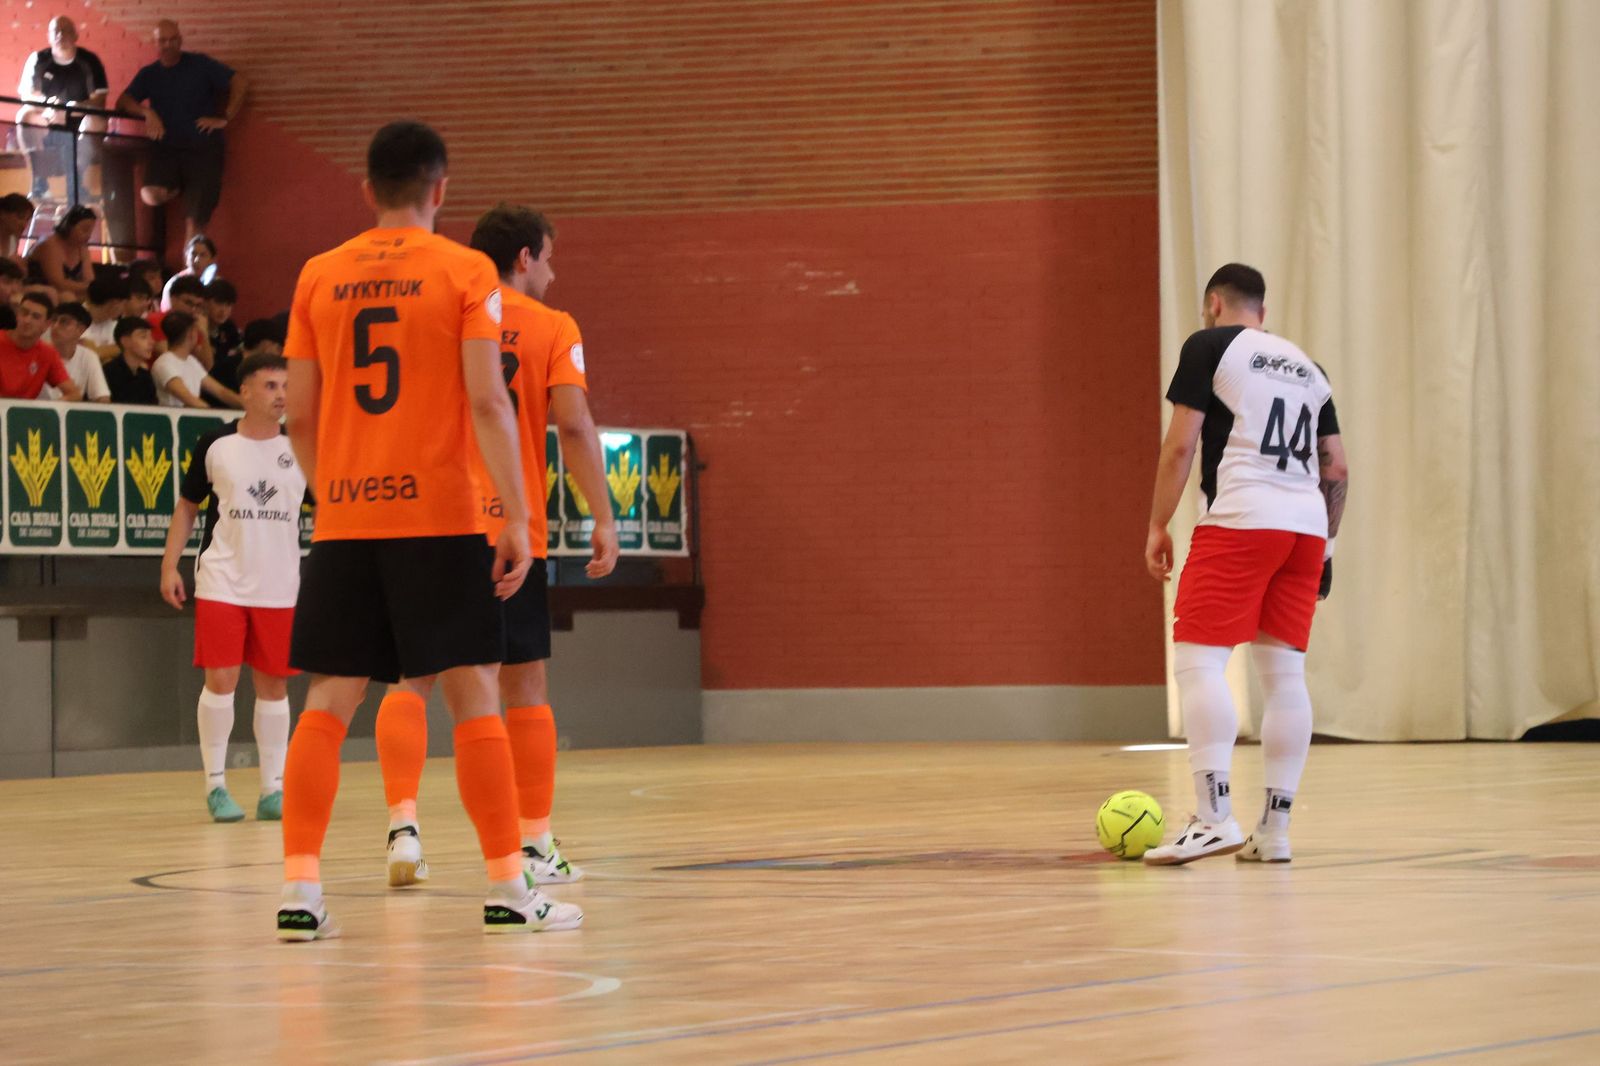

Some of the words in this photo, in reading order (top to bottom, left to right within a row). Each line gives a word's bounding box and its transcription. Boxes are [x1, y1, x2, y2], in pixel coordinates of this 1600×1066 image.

[334, 280, 423, 301] MYKYTIUK
[353, 307, 399, 414] 5
[1260, 398, 1312, 474] 44
[329, 475, 418, 503] uvesa
[229, 509, 254, 519] CAJA
